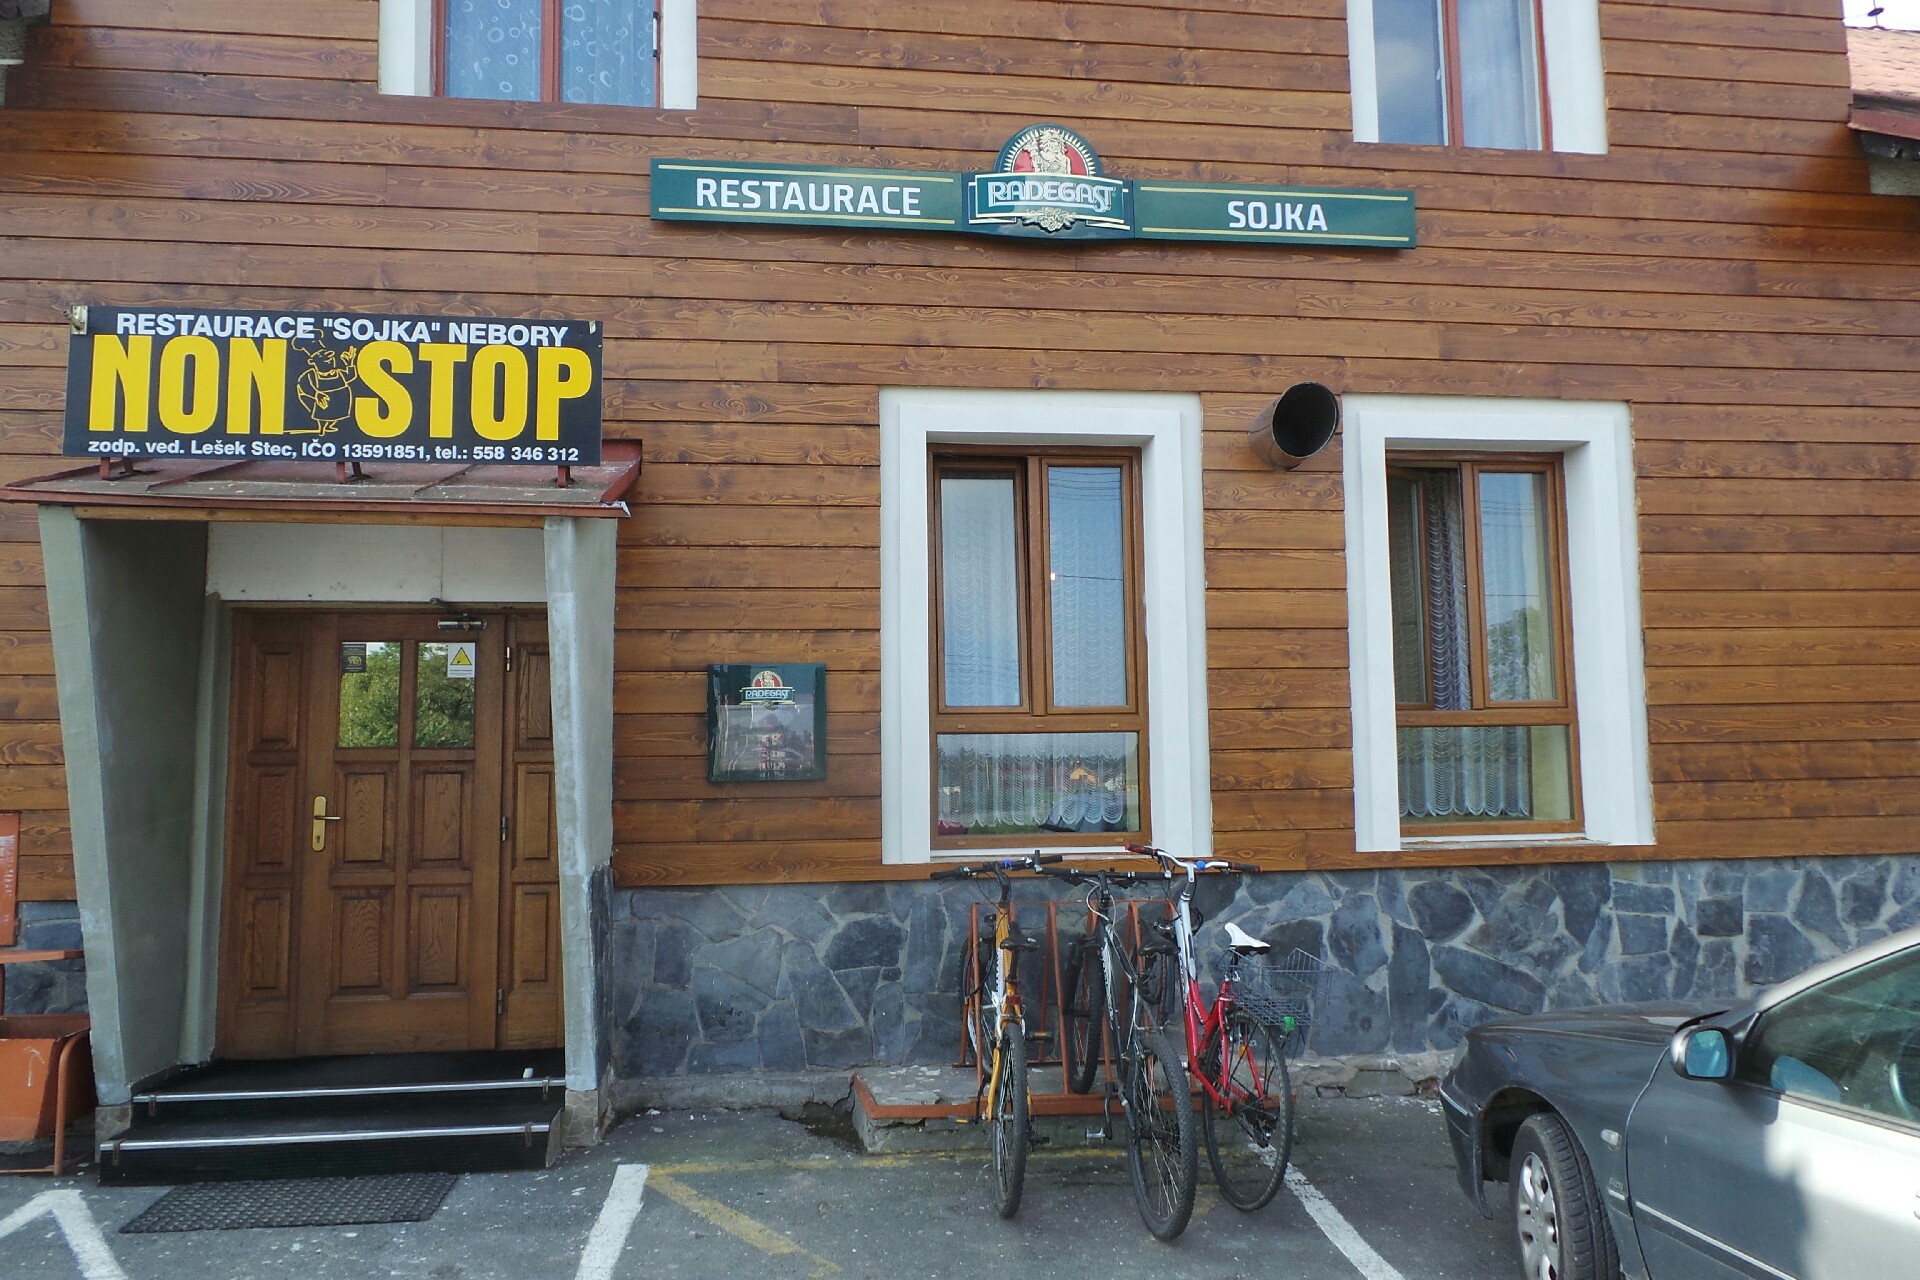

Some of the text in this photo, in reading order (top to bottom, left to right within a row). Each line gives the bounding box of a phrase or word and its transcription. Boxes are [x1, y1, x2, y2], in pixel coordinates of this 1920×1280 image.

[696, 178, 921, 215] RESTAURACE
[988, 180, 1113, 213] RADEGAST
[1227, 200, 1328, 231] SOJKA
[117, 313, 569, 347] RESTAURACE "SOJKA" NEBORY
[89, 334, 592, 441] NON STOP
[88, 438, 579, 462] zodp. ved. Lešek Stec, IČO 13591851, tel.: 558 346 312
[745, 690, 790, 700] RADEGAST
